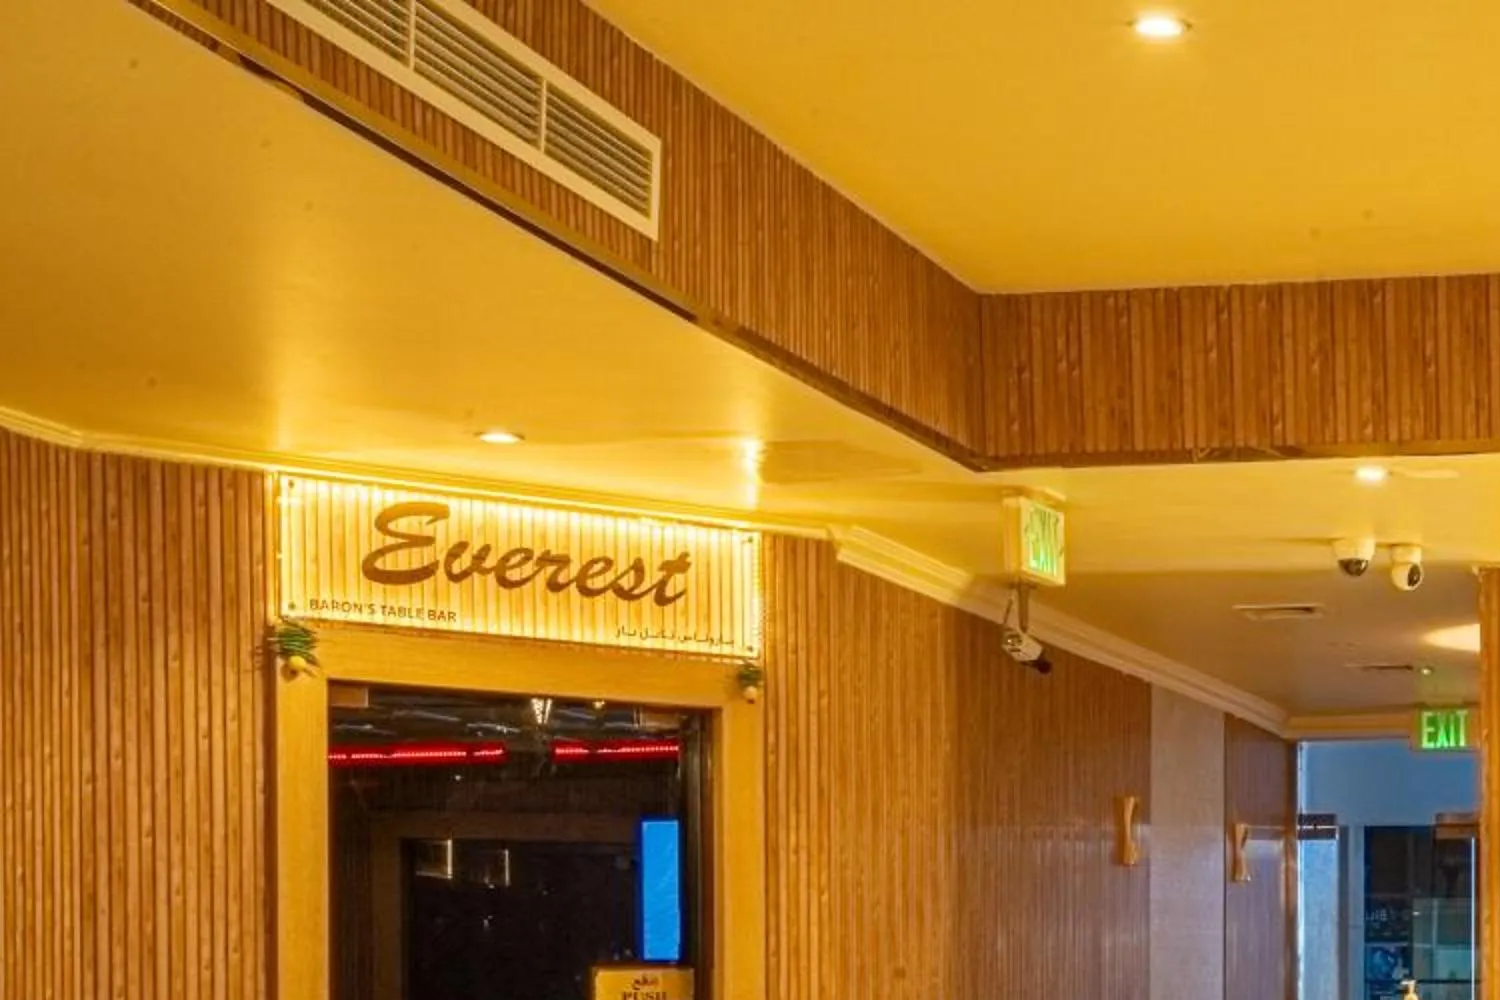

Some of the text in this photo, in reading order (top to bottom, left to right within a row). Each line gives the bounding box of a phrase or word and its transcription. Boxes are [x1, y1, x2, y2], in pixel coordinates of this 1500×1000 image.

[361, 501, 692, 607] Everest
[309, 598, 457, 622] BARON'S TABLE BAR
[1422, 709, 1468, 749] EXIT
